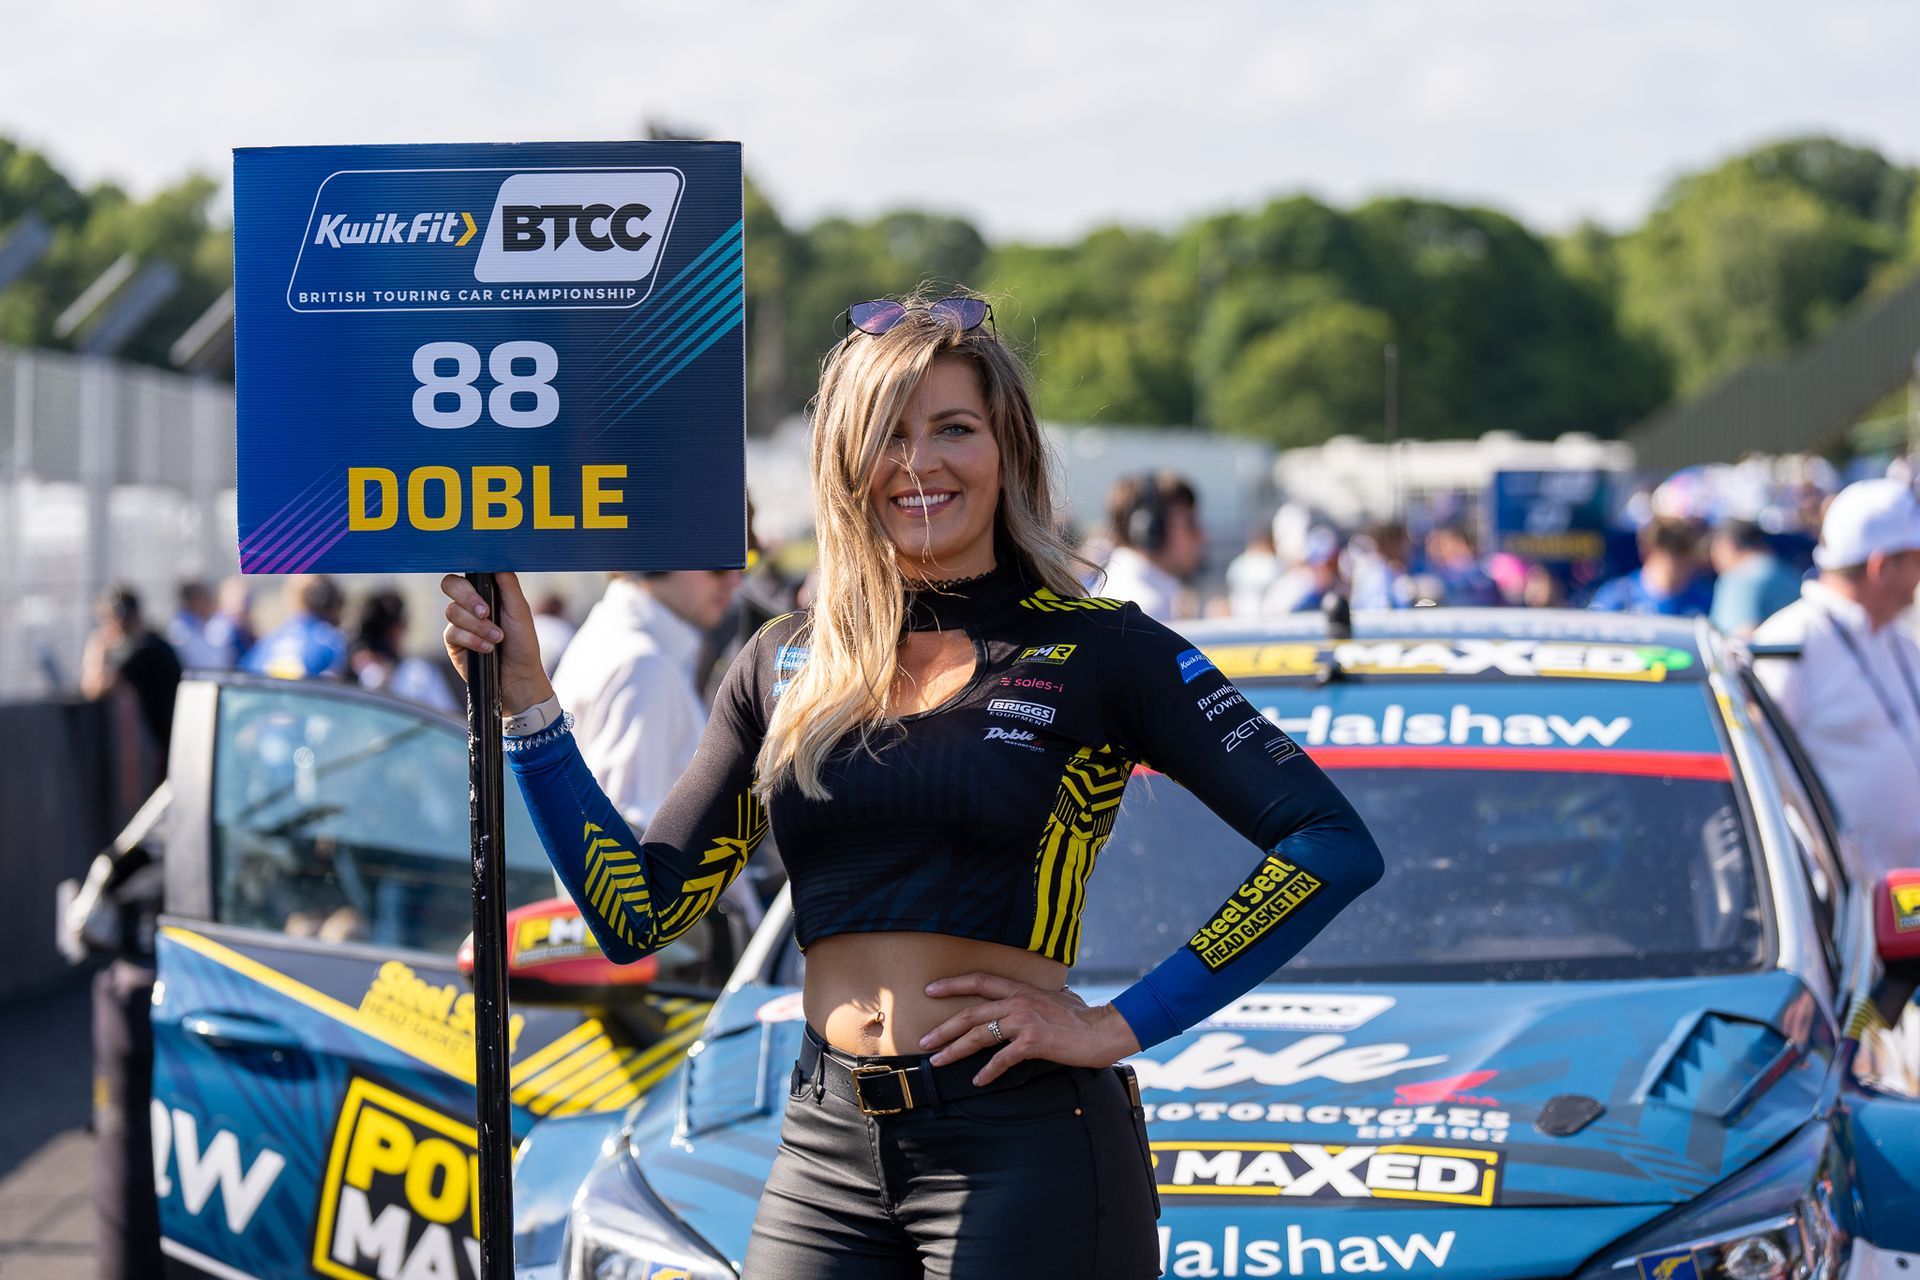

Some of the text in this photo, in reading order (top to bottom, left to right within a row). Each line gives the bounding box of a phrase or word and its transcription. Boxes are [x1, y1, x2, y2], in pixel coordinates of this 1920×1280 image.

[502, 203, 653, 252] BTCC
[299, 288, 637, 303] BRITISH TOURING CAR CHAMPIONSHIP
[412, 340, 560, 429] 88
[348, 464, 629, 532] DOBLE
[992, 701, 1051, 719] BRIGGS
[1014, 678, 1064, 693] sales-i
[1197, 684, 1238, 711] Bramley
[1205, 694, 1245, 722] POWER
[981, 727, 1037, 741] Doble
[989, 711, 1047, 727] EQUIPMENT
[1190, 856, 1296, 951] Steel Seal
[1204, 874, 1318, 966] HEAD GASKET FIX
[345, 1105, 480, 1240] PO
[1172, 1143, 1480, 1198] MAXED
[331, 1183, 481, 1280] MA
